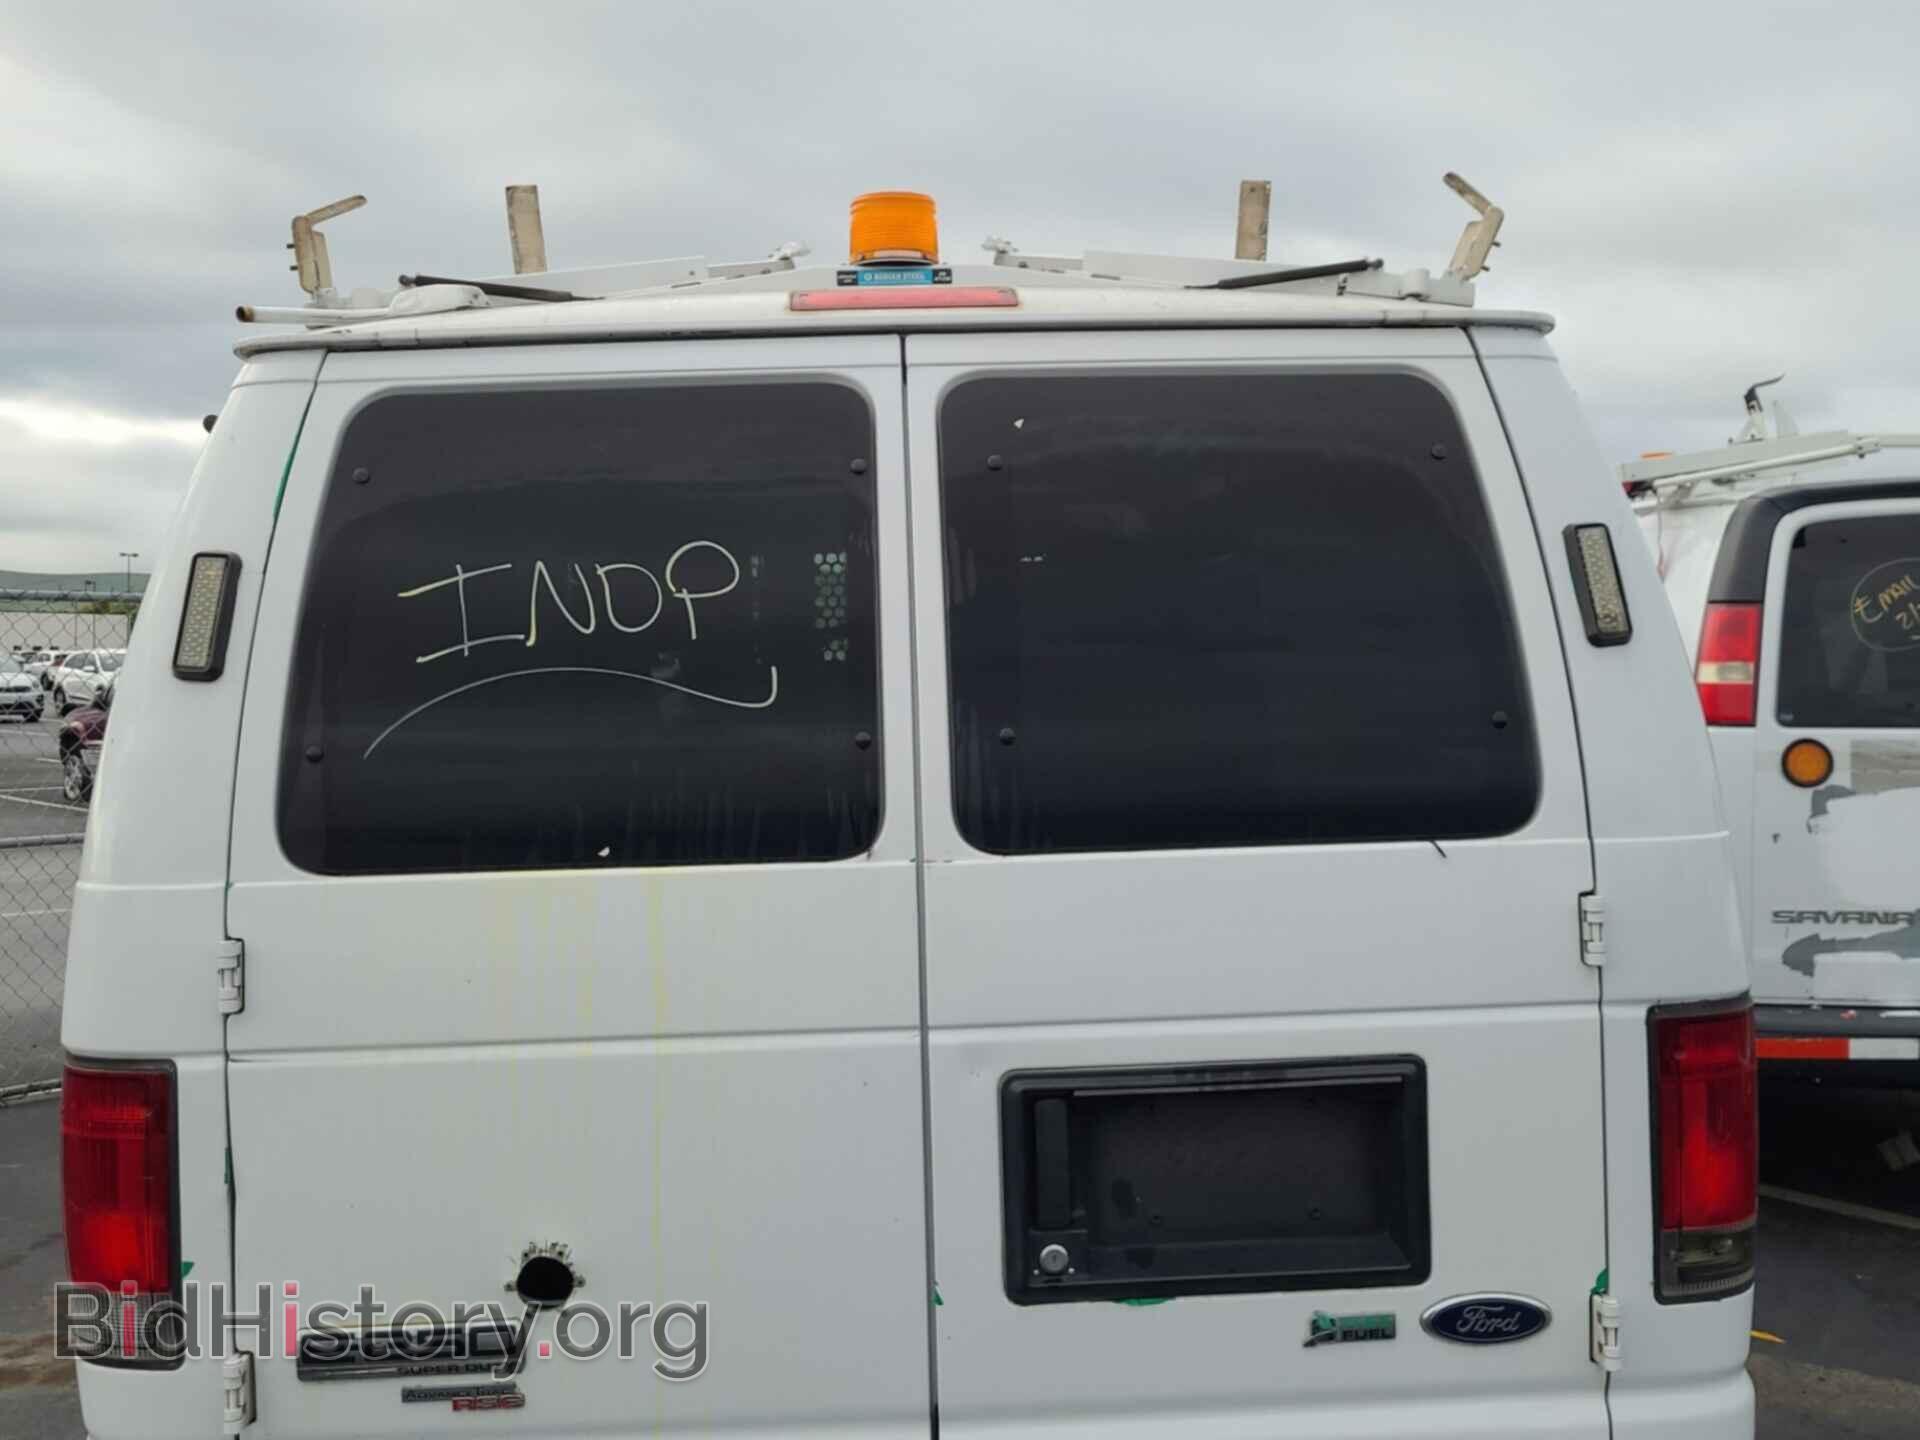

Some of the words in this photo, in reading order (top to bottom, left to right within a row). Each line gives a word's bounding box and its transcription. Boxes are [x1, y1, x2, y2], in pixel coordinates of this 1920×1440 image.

[1456, 1305, 1521, 1332] Ford
[1342, 1328, 1395, 1342] FUEL
[452, 1394, 525, 1412] RSC
